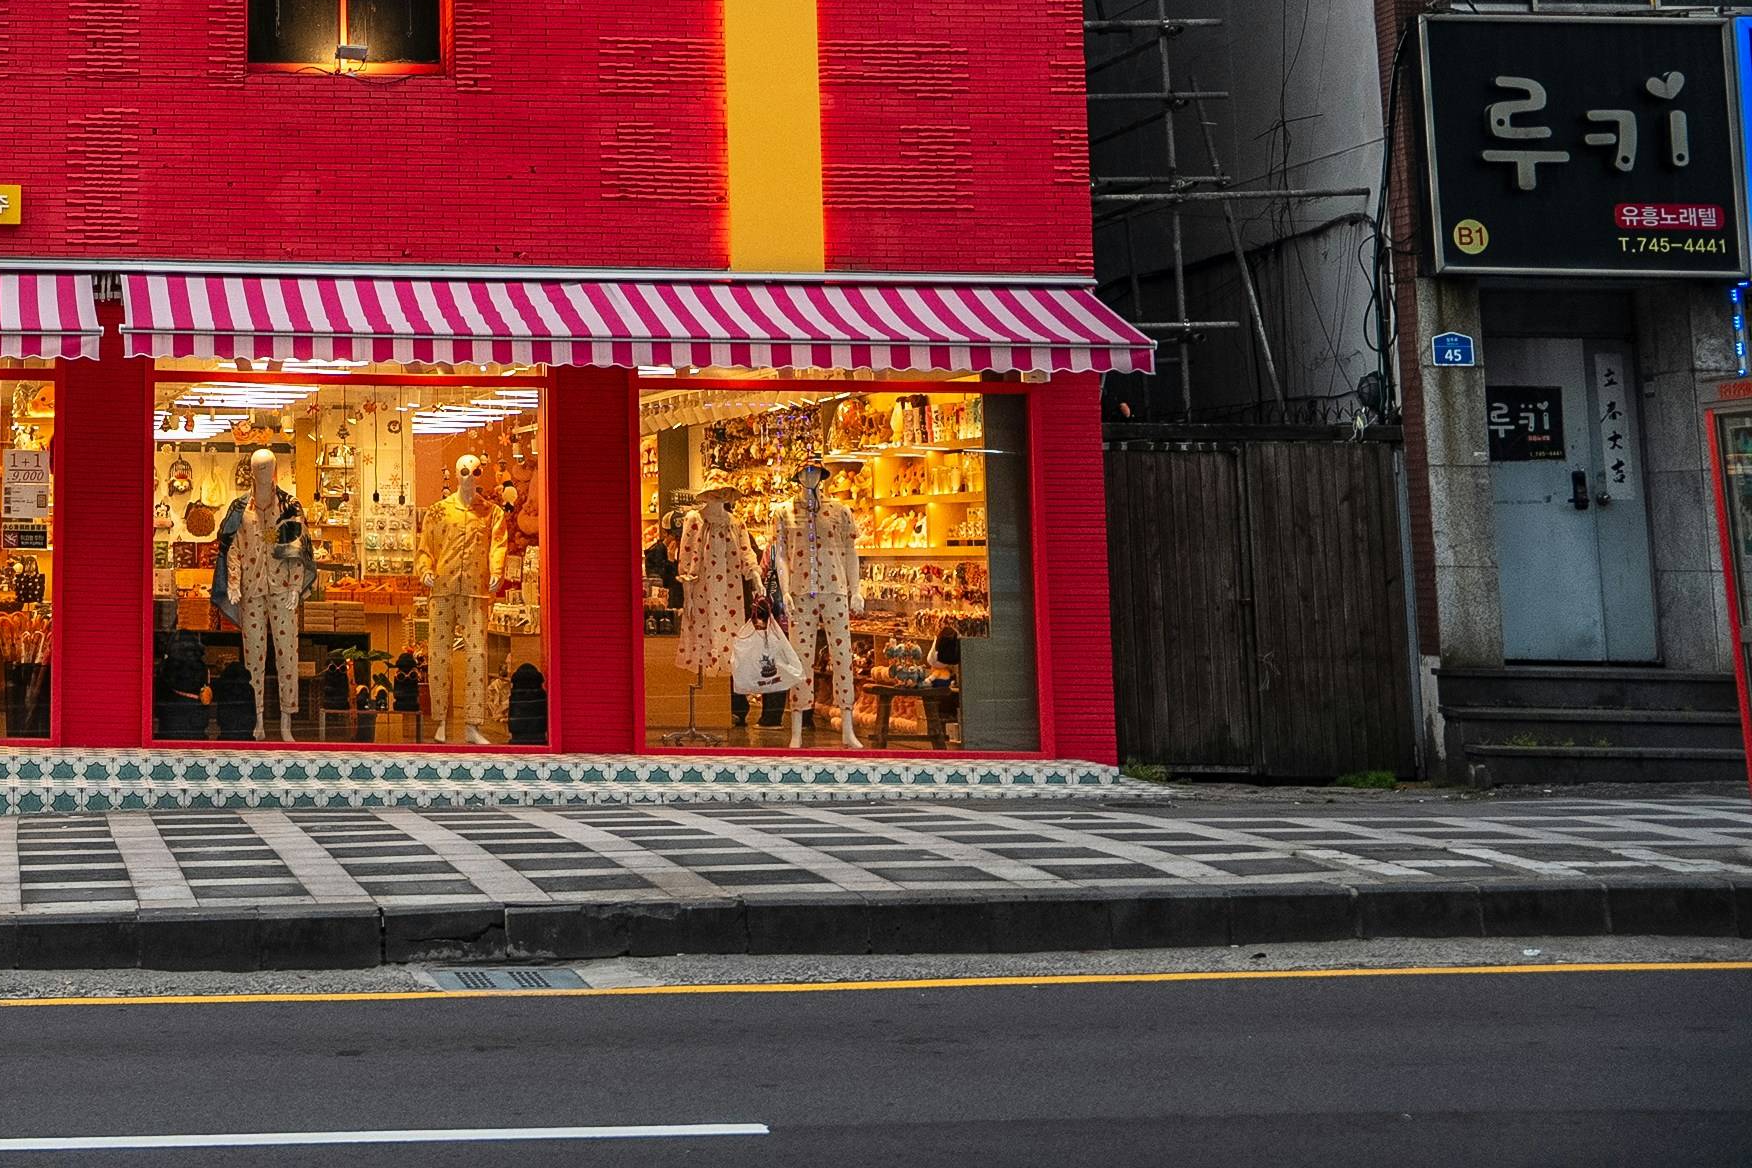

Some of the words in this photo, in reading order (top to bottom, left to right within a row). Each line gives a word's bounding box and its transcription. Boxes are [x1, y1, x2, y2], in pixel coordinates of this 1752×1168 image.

[1482, 71, 1690, 191] 루키
[1621, 206, 1717, 227] 유흥노래텔
[1457, 226, 1485, 247] B1
[1618, 237, 1727, 254] T.745-4441
[1444, 349, 1462, 362] 45
